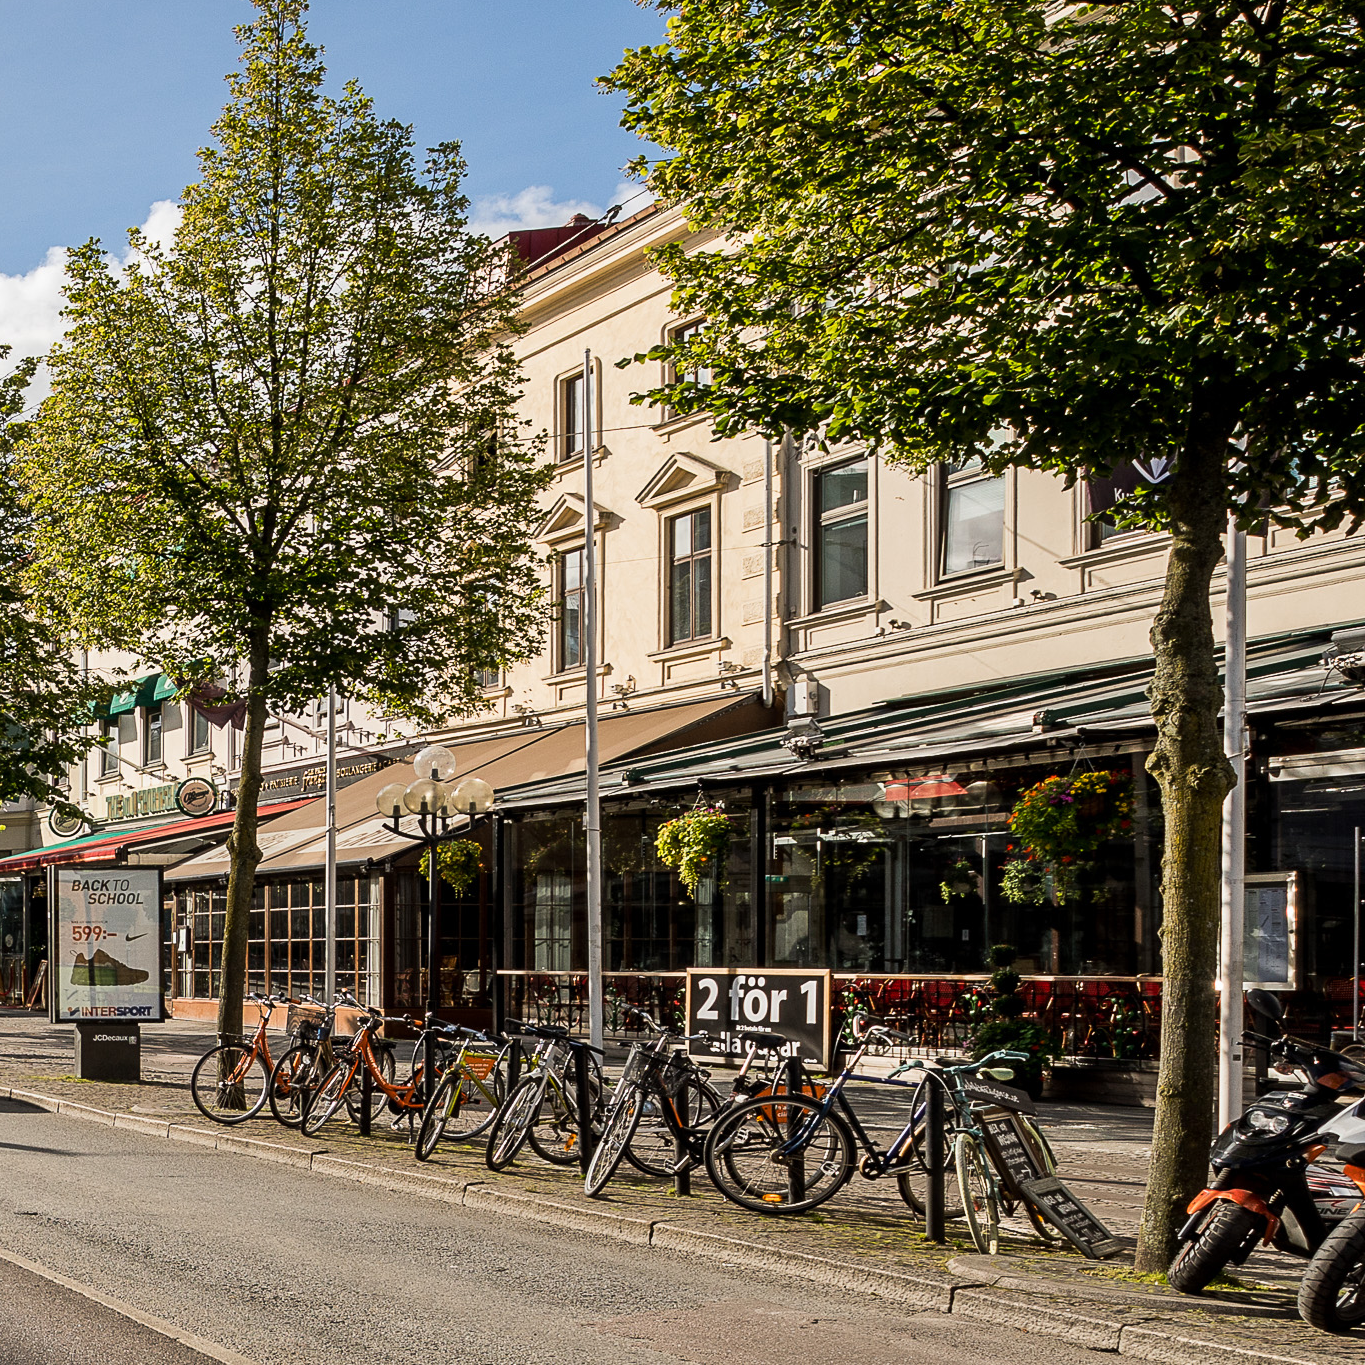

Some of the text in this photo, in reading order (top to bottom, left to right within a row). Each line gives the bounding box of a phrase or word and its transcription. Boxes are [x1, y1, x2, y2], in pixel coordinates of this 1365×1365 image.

[72, 880, 129, 892] BACK TO
[88, 893, 144, 904] SCHOOL
[697, 975, 817, 1024] 2 för 1
[81, 1007, 152, 1016] INTERSPORT
[93, 1034, 128, 1042] JCDecaux
[1317, 1208, 1349, 1216] INE
